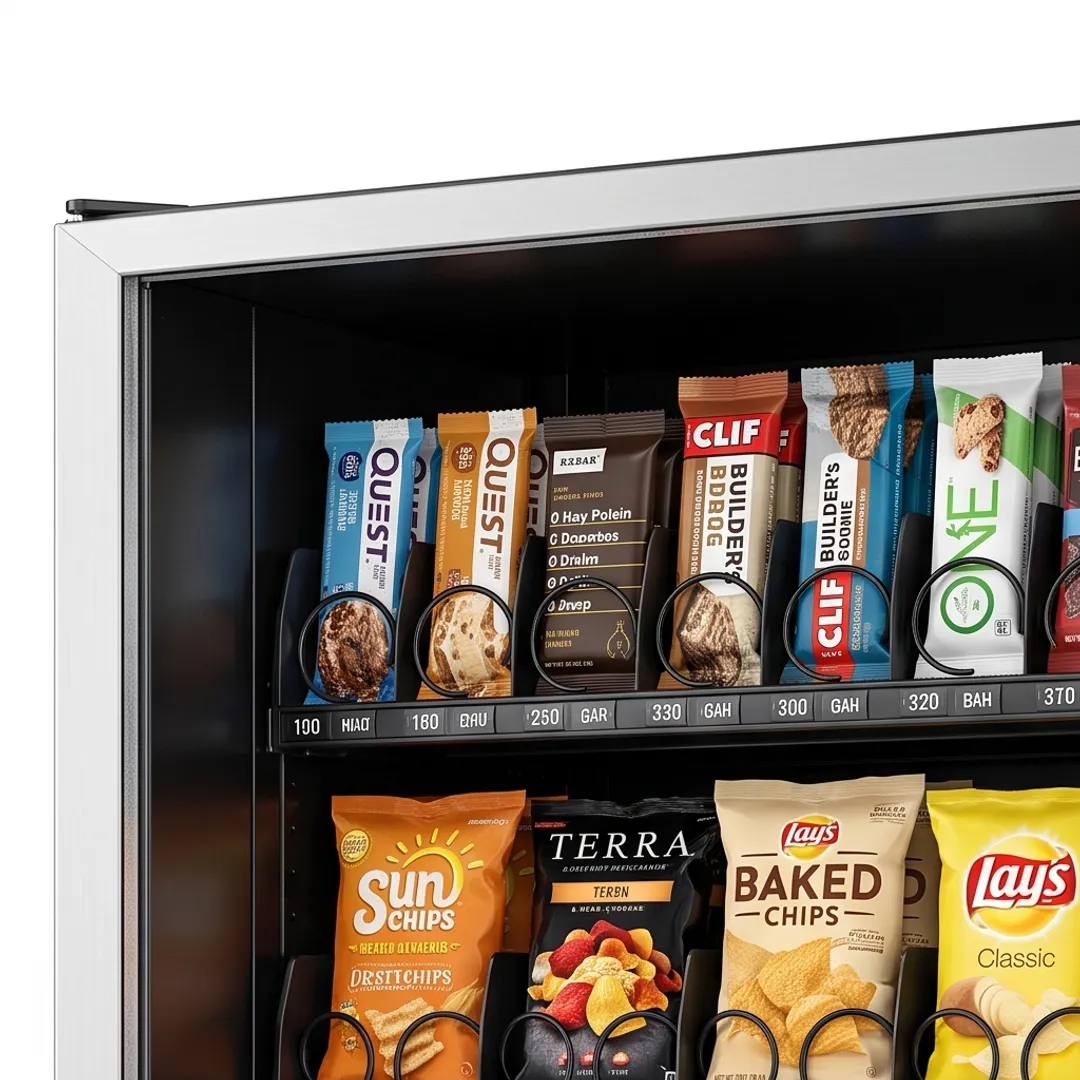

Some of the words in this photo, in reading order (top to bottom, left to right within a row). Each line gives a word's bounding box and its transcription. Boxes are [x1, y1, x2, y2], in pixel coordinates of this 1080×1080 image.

[692, 418, 762, 450] CLIF
[366, 447, 400, 564] QUEST
[480, 437, 516, 554] QUEST
[817, 578, 845, 649] CLIF
[831, 697, 860, 714] GAH
[909, 693, 940, 711] 320
[963, 691, 992, 708] BAH
[1044, 687, 1075, 705] 370
[581, 707, 608, 724] GAR
[652, 703, 682, 721] 330
[778, 699, 808, 716] 300
[549, 830, 695, 860] TERRA
[783, 820, 839, 849] Lay's
[735, 863, 882, 902] BAKED
[971, 854, 1072, 910] Lay's
[387, 909, 455, 931] CHIPS
[764, 905, 840, 927] CHIPS
[977, 947, 1056, 969] Classic
